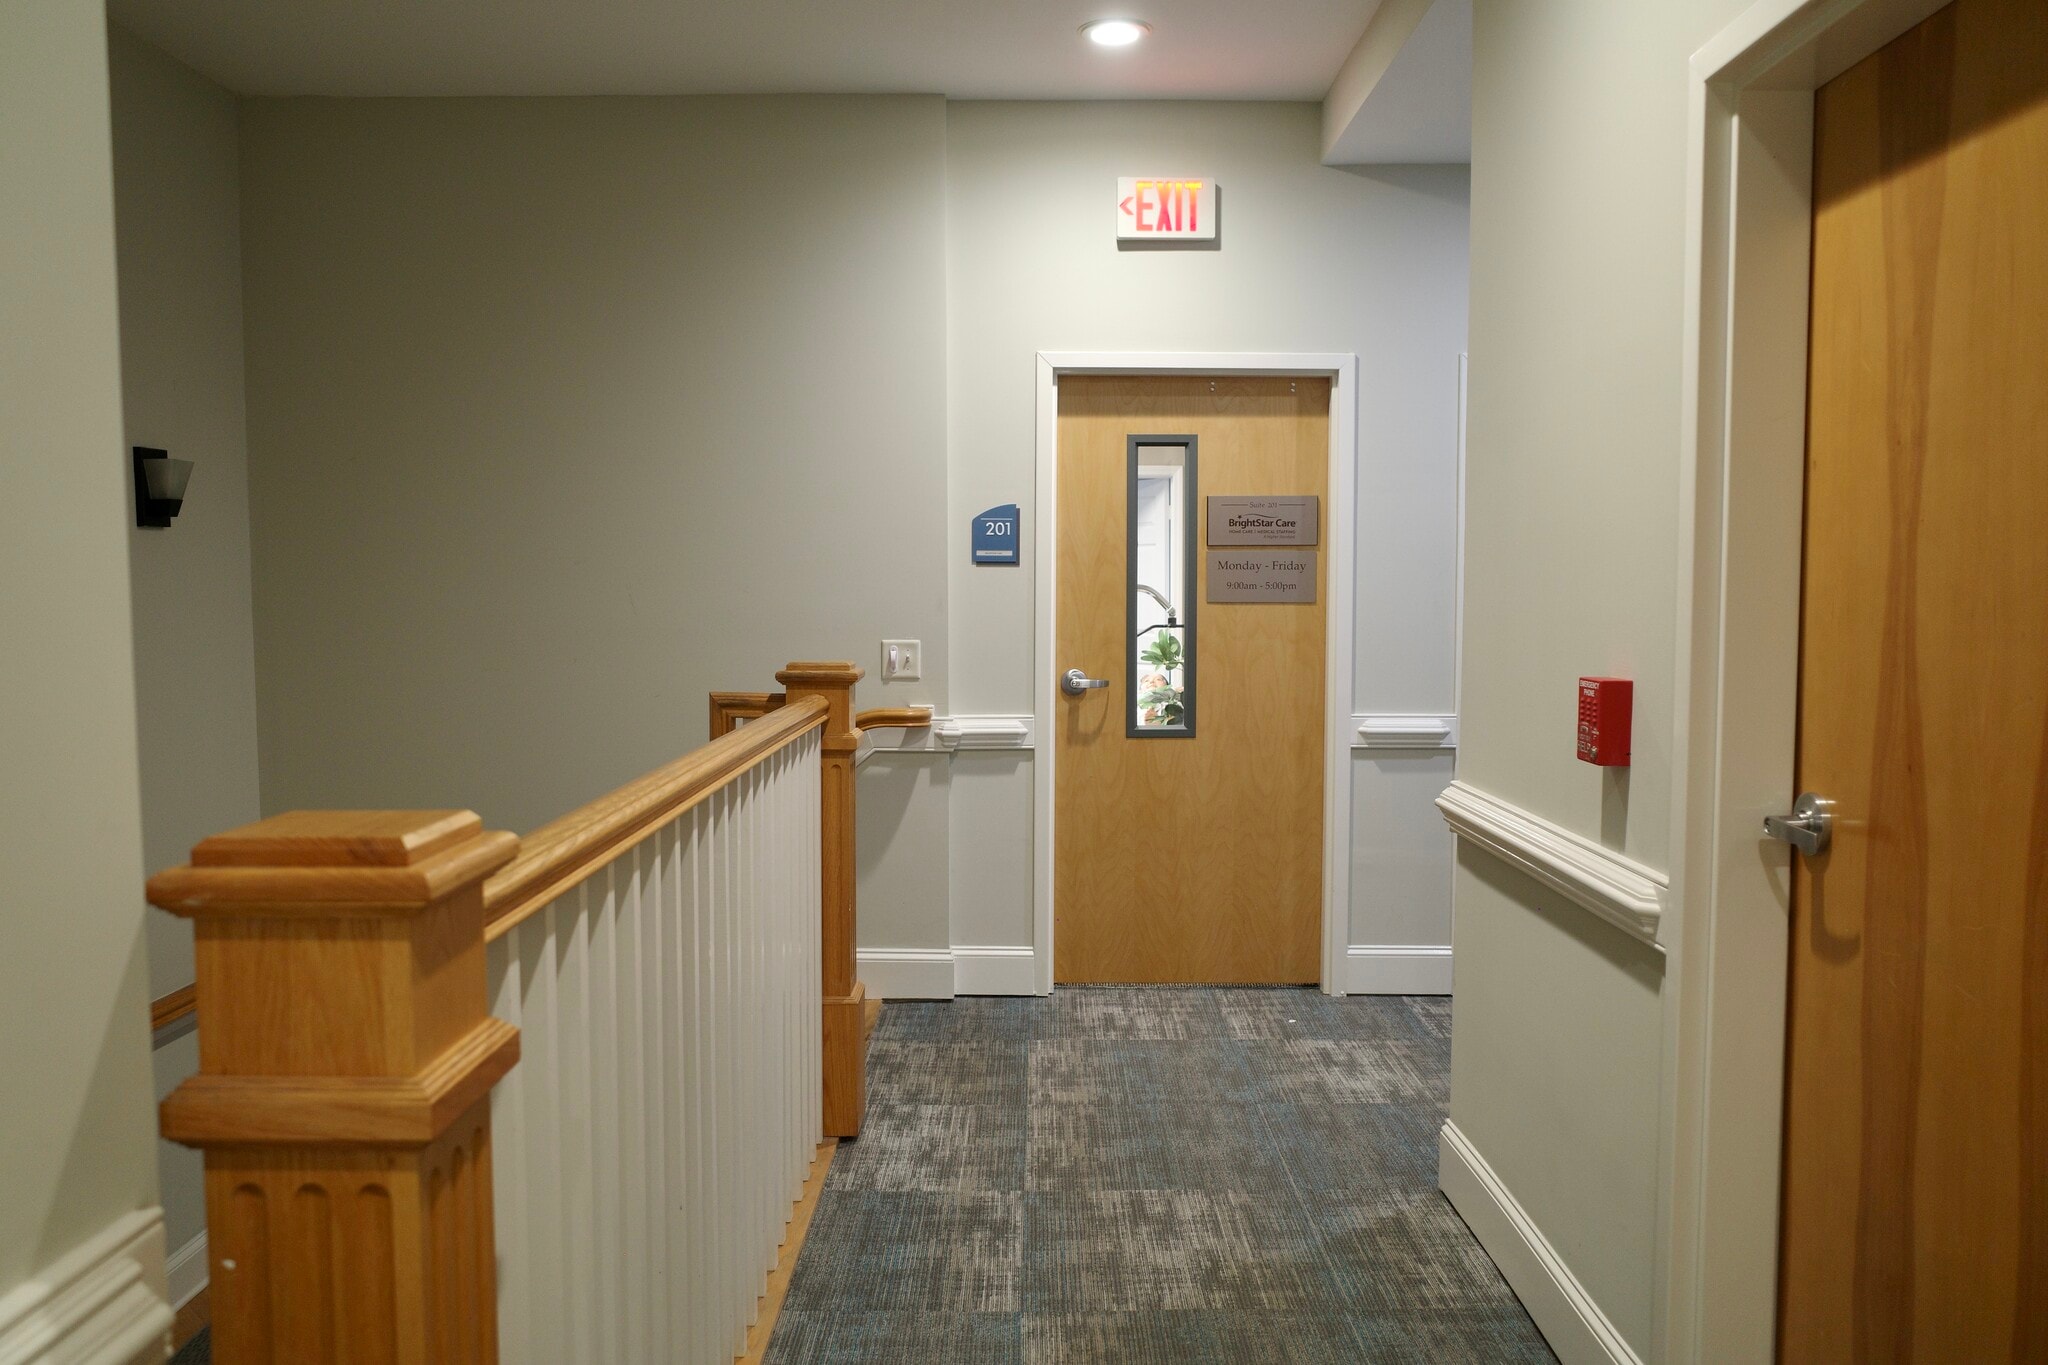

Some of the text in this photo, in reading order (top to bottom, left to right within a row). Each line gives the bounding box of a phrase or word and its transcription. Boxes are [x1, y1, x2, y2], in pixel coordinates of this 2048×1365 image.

[1136, 181, 1203, 231] EXIT
[985, 522, 1011, 536] 201
[1229, 518, 1296, 529] BrightStar Care
[1218, 560, 1262, 573] Monday
[1272, 560, 1306, 573] Friday
[1226, 581, 1257, 590] 9:00am
[1265, 581, 1297, 592] 5:00pm
